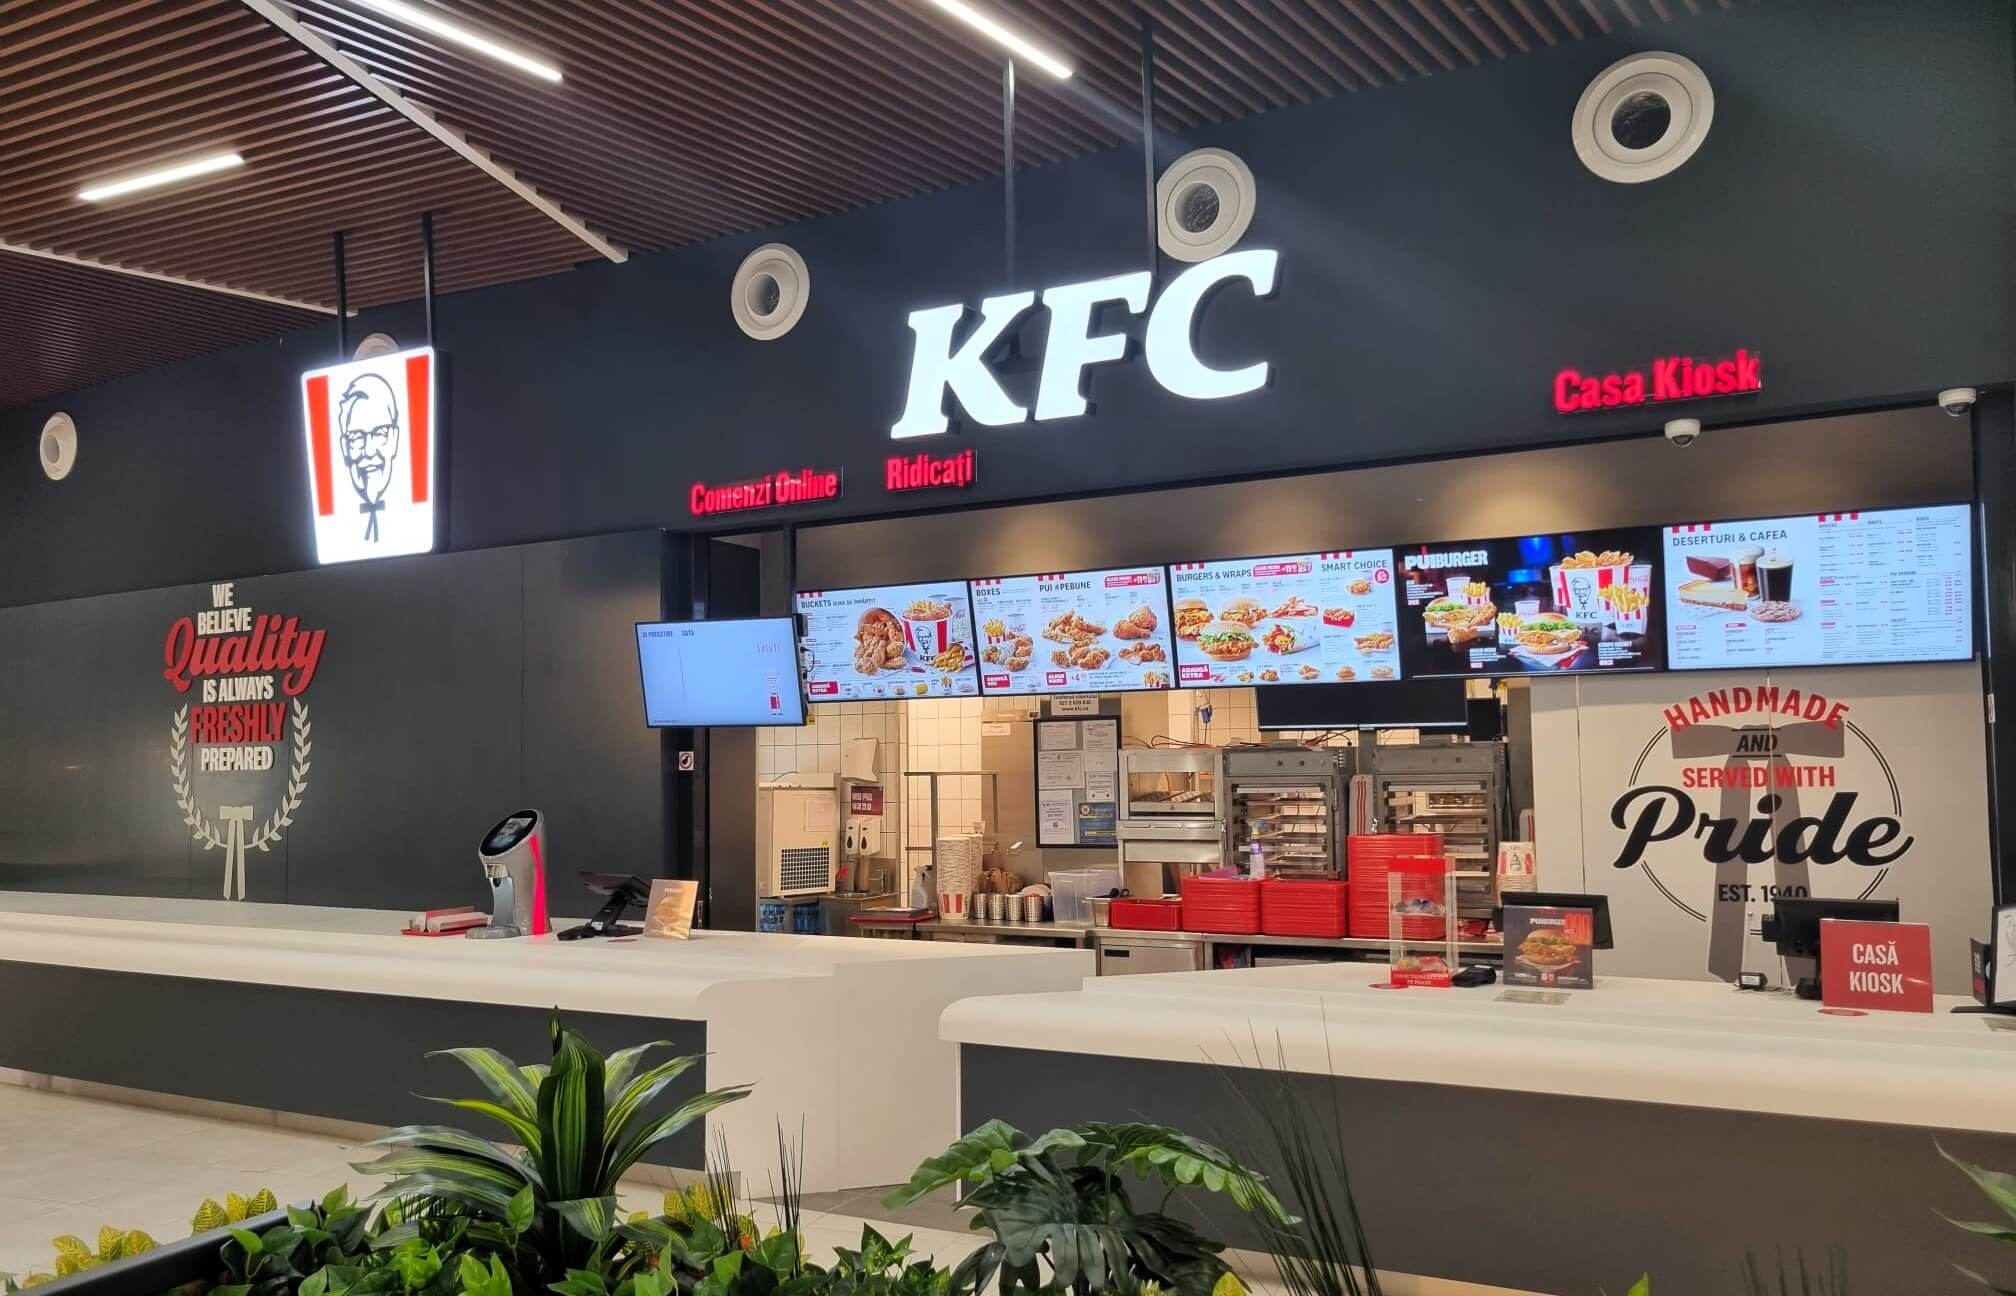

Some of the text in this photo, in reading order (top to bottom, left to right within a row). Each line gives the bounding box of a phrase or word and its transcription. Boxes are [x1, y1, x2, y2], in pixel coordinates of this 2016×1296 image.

[889, 248, 1279, 440] KFC
[1553, 348, 1760, 412] Casa Kiosk
[690, 469, 837, 515] Comenzi Online
[1672, 529, 1788, 546] DESERTURI & CAFEA
[1176, 570, 1214, 582] BURGERS
[1214, 570, 1221, 580] &
[1222, 569, 1252, 579] WRAPS
[1321, 560, 1388, 572] SMART CHOICE
[212, 582, 235, 608] WE
[976, 588, 1000, 597] BOXES
[1039, 584, 1053, 592] PUI
[801, 599, 832, 608] BUCKETS
[1575, 611, 1598, 619] KFC
[197, 607, 252, 636] BELIEVE
[162, 614, 328, 696] Quality
[203, 675, 274, 703] IS ALWAYS
[1663, 686, 1850, 733] HANDMADE
[190, 703, 288, 744] FRESHLY
[1736, 734, 1778, 752] AND
[201, 746, 274, 771] PREPARED
[1682, 766, 1835, 788] SERVED WITH
[1611, 785, 1915, 869] Pride
[1718, 884, 1808, 902] EST. 1940
[1852, 940, 1899, 966] CASĂ
[1849, 971, 1904, 994] KIOSK
